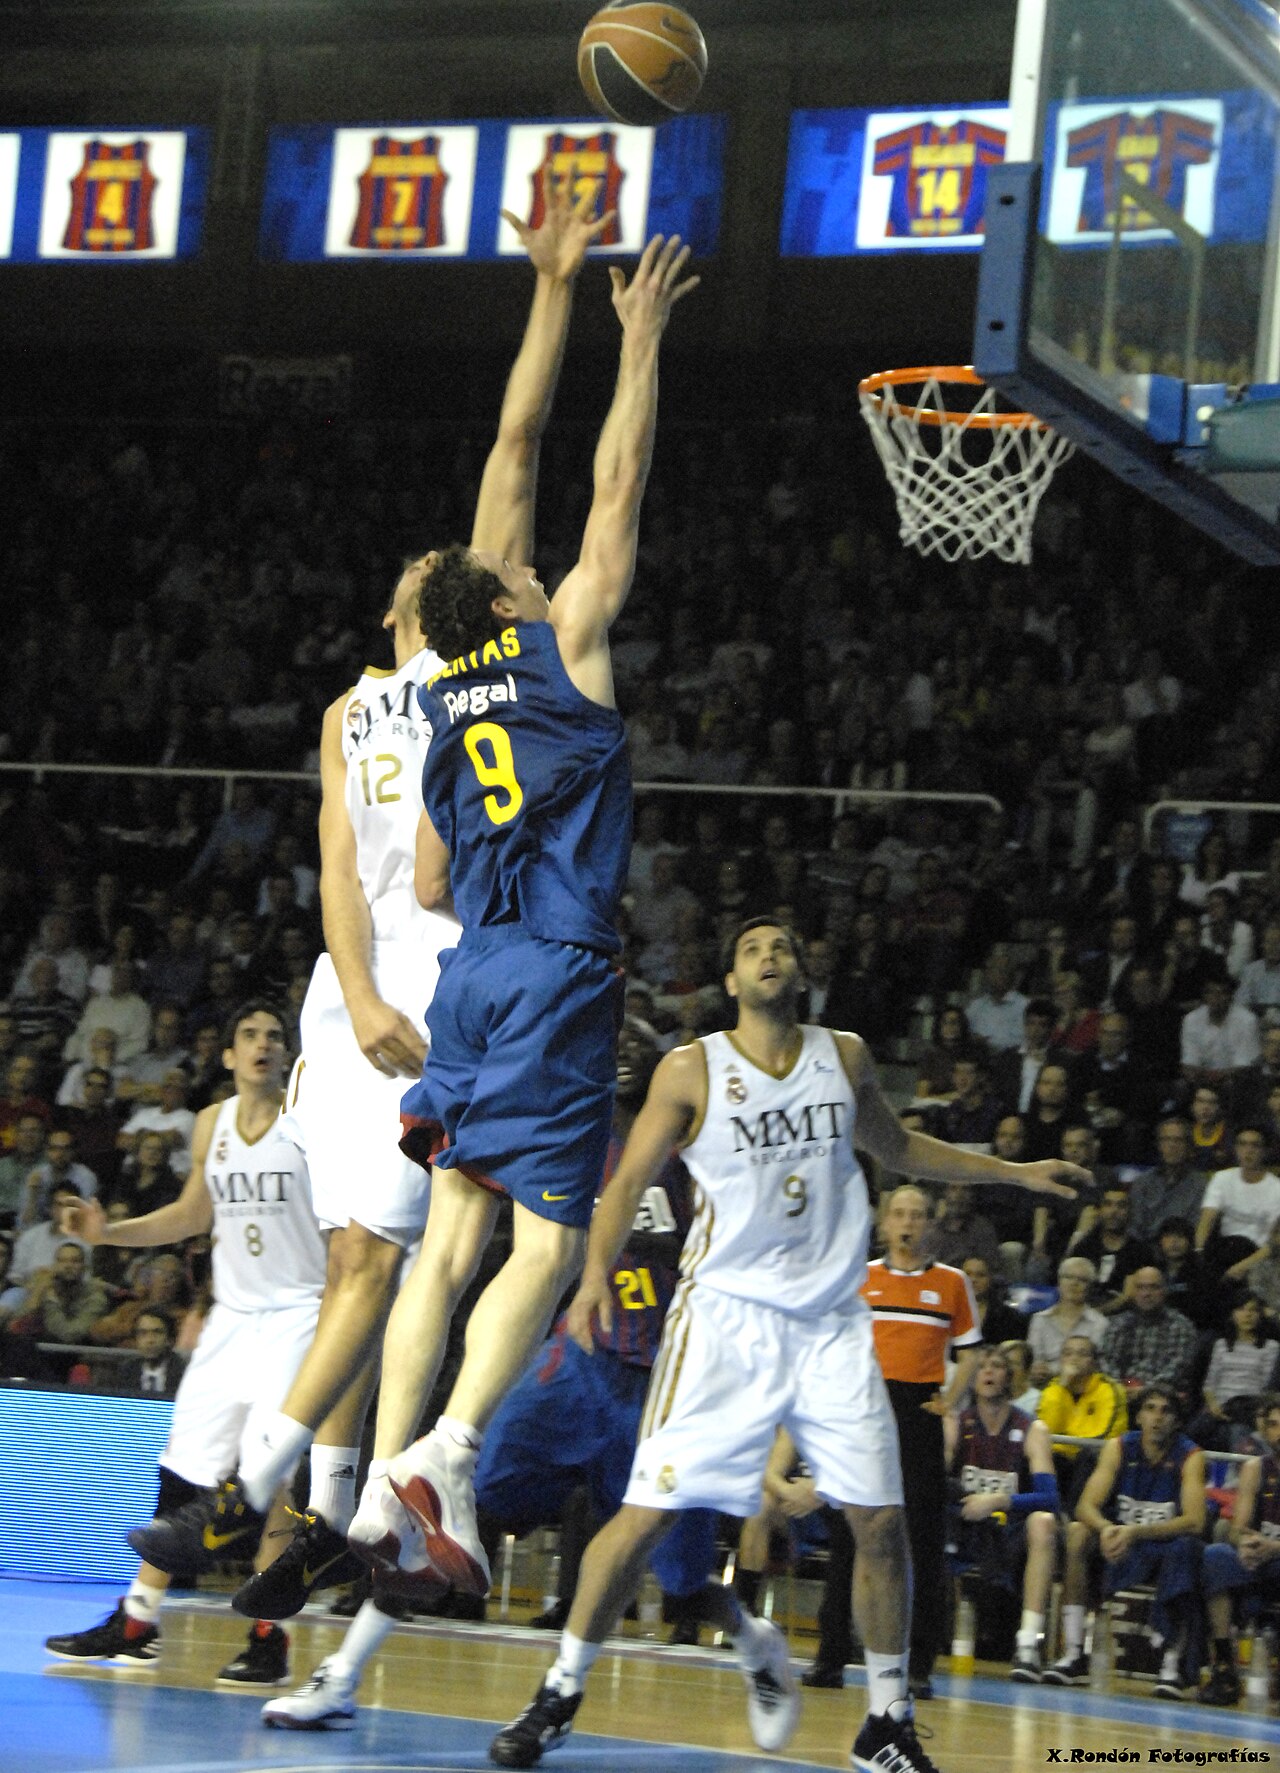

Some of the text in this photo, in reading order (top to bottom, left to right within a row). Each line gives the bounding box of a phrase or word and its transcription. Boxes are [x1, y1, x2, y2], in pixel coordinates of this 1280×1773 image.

[917, 169, 961, 217] 14
[443, 673, 518, 723] Regal
[359, 753, 403, 806] 12
[463, 722, 524, 825] 9
[729, 1101, 845, 1153] MMT
[211, 1171, 294, 1205] MMT
[783, 1174, 807, 1218] 9
[244, 1222, 264, 1257] 8
[614, 1267, 658, 1310] 21
